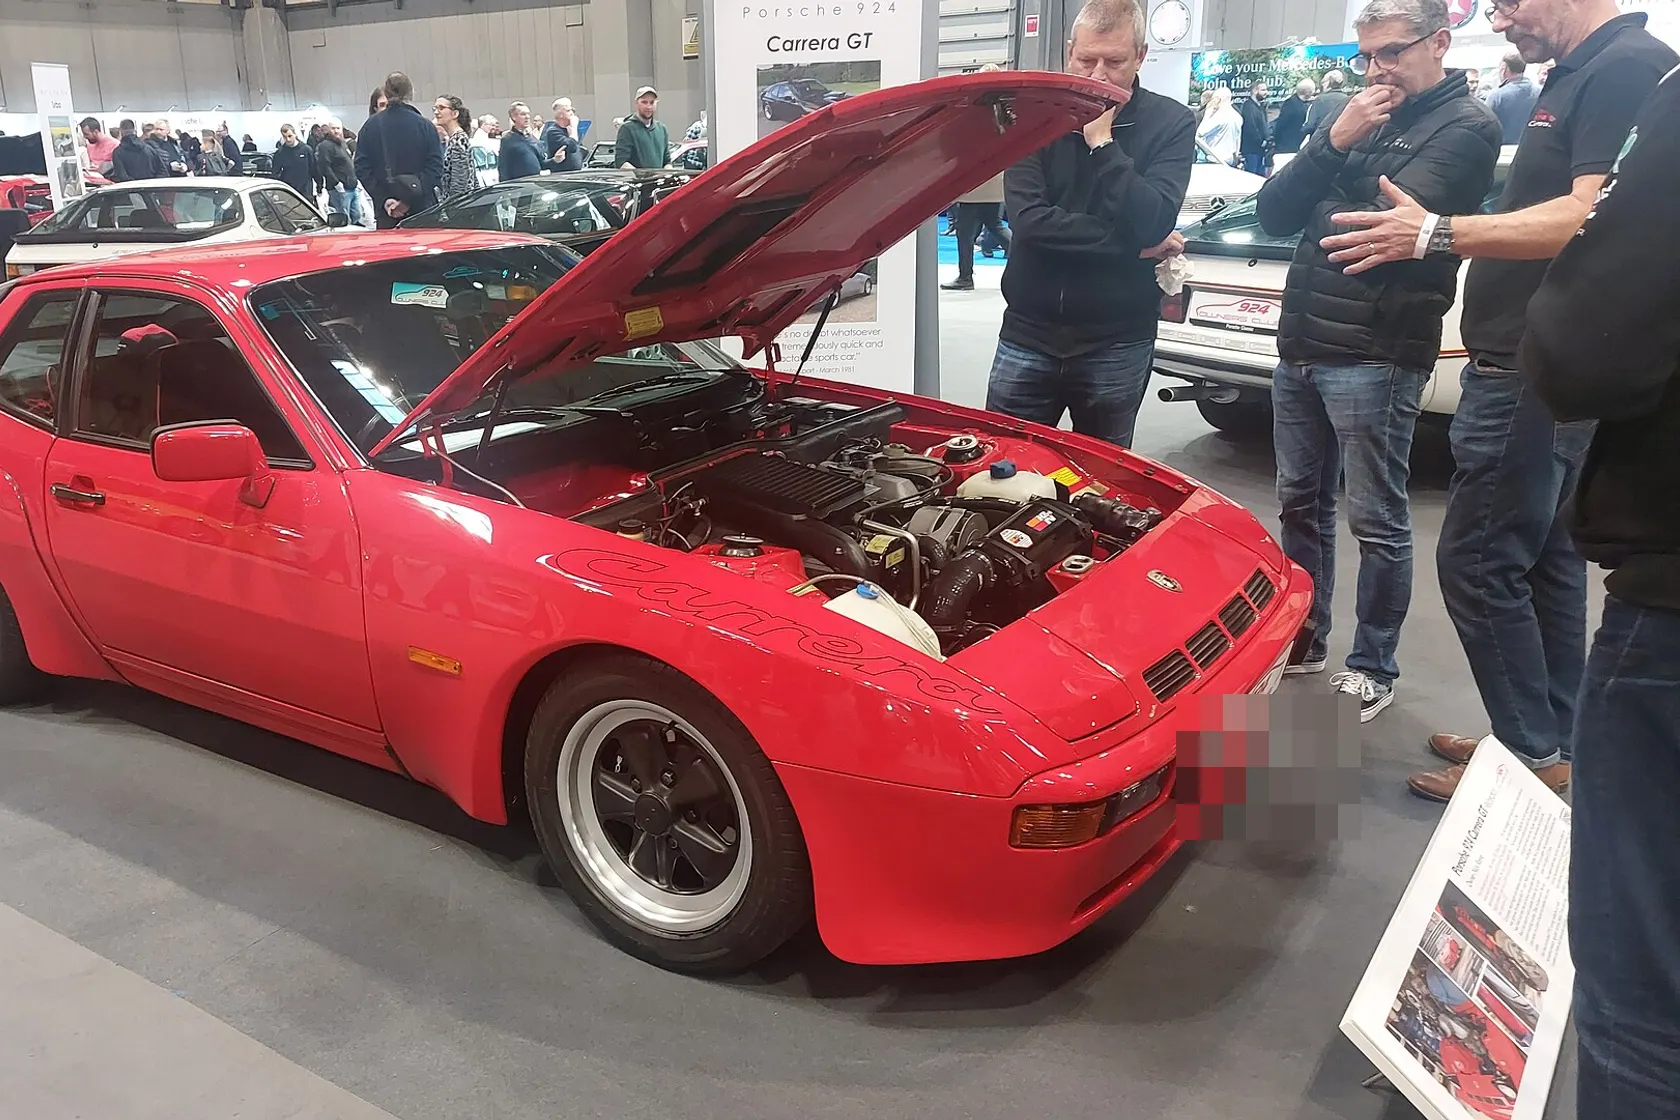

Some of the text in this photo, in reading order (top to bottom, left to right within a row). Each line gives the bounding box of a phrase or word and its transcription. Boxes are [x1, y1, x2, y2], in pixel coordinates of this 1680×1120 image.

[743, 1, 896, 19] Porsche 924
[766, 32, 873, 53] Carrera GT
[1235, 62, 1265, 77] your
[1202, 77, 1228, 91] Join
[1231, 77, 1251, 89] the
[421, 289, 444, 298] 924
[1238, 302, 1271, 315] 924
[830, 328, 882, 337] whatsoever
[781, 339, 884, 351] tremedously quick and
[814, 353, 839, 362] sports
[555, 548, 1003, 714] Carrera
